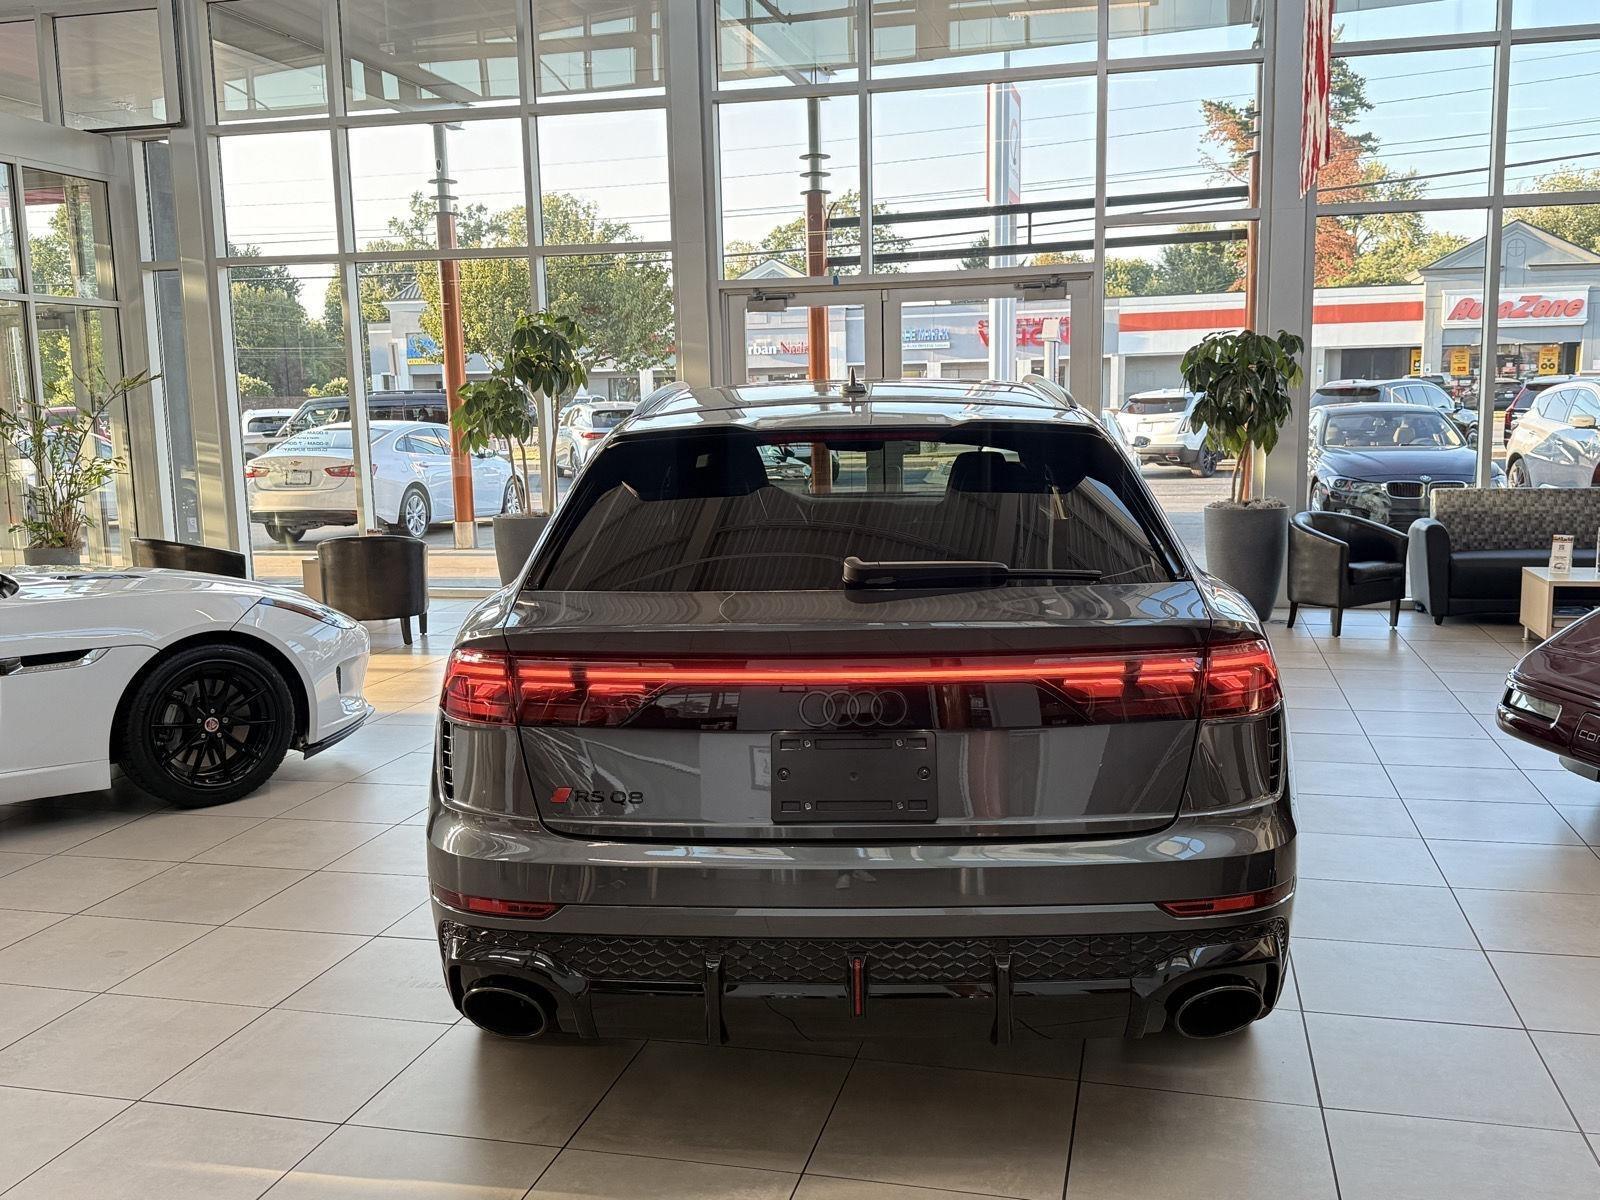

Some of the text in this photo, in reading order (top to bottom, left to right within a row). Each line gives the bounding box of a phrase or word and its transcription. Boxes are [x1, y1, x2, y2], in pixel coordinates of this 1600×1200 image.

[1447, 295, 1585, 320] AuoZone
[748, 342, 777, 355] rban
[574, 789, 644, 806] RS Q8
